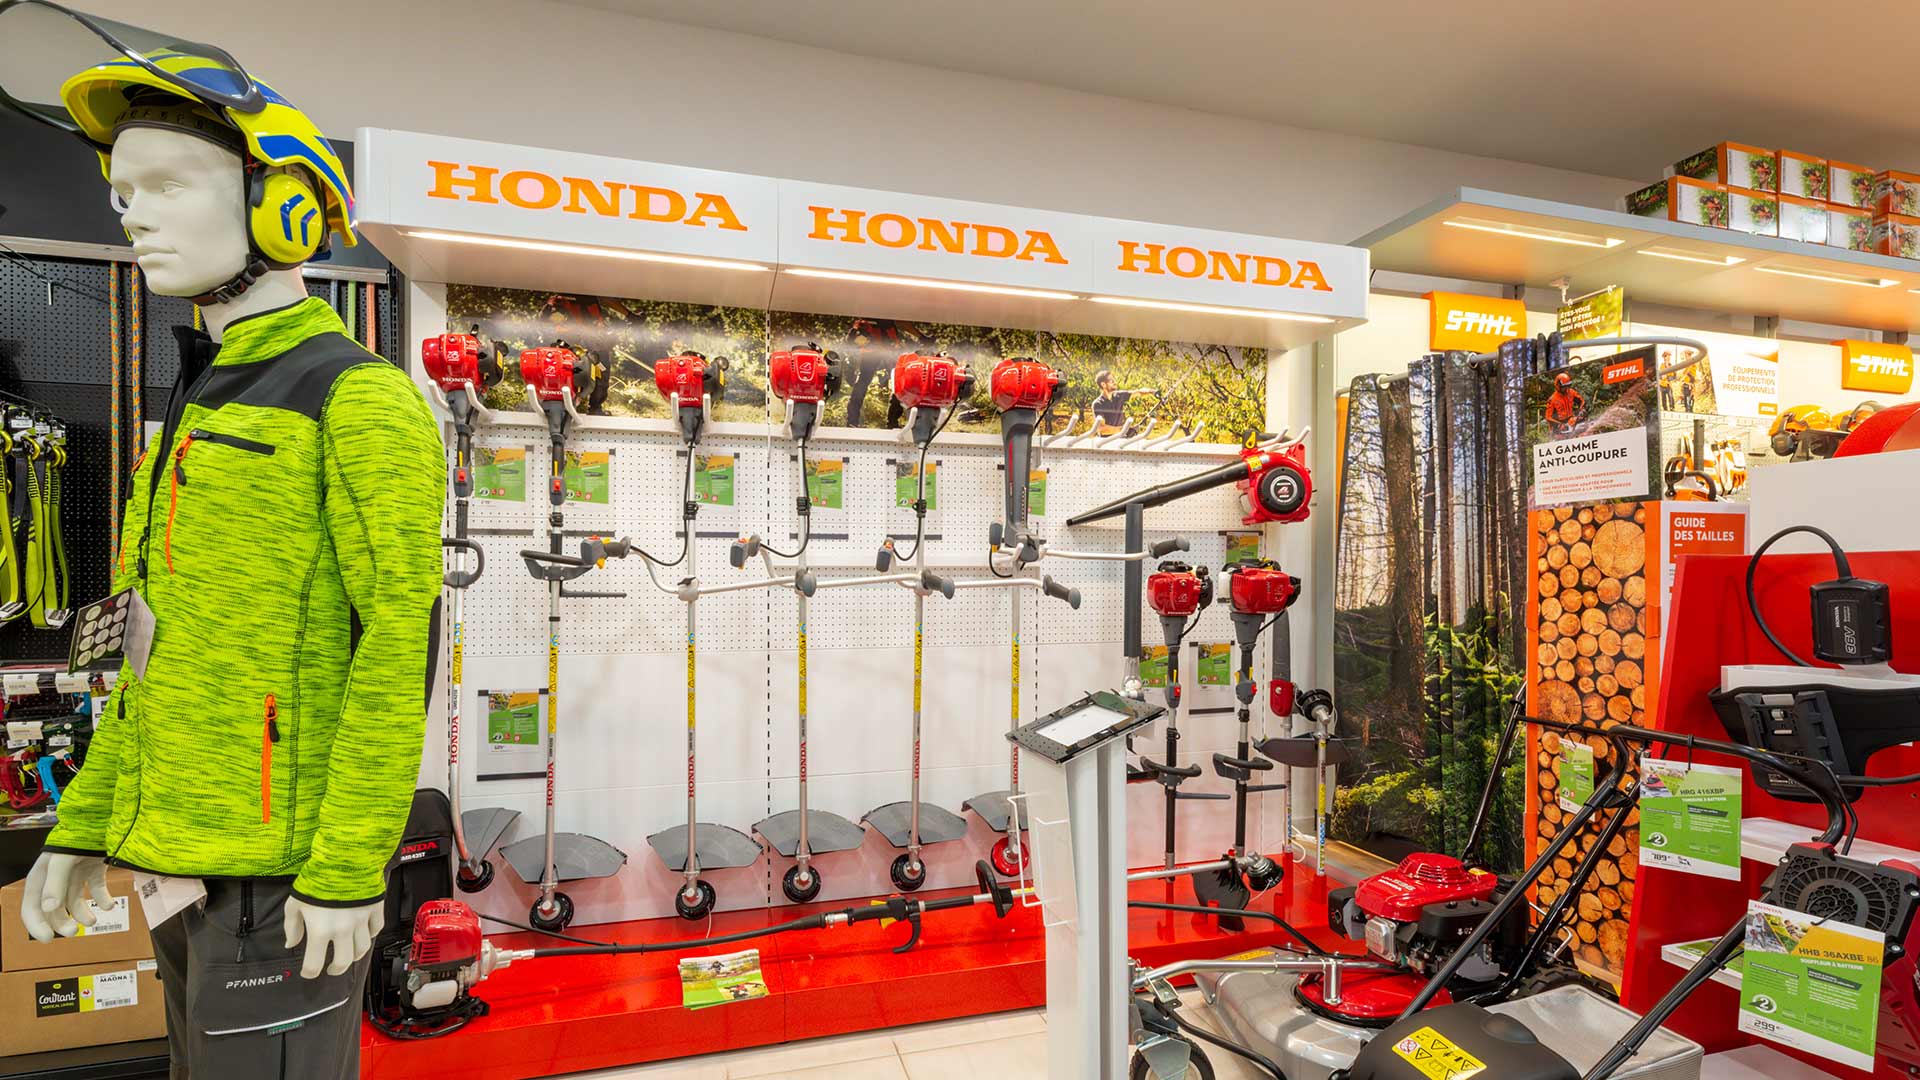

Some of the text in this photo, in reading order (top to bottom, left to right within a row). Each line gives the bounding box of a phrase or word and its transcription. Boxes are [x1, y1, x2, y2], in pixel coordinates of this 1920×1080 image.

[426, 159, 748, 232] HONDA
[807, 205, 1069, 265] HONDA
[1117, 239, 1334, 292] HONDA
[1444, 309, 1519, 337] STIHL
[1606, 364, 1640, 380] STIHL
[1849, 354, 1909, 377] STIHL
[1722, 383, 1776, 395] PROFESSIONNELS
[1727, 374, 1776, 386] DE PROTECTION
[1539, 439, 1599, 458] LA GAMME
[1539, 447, 1628, 470] ANTI-COUPURE
[1674, 517, 1706, 528] GUIDE
[1674, 530, 1735, 542] DES TAILLES
[1843, 626, 1857, 654] 36V
[450, 714, 459, 764] HONDA
[546, 761, 554, 807] HONDA
[687, 754, 695, 798] HONDA
[1798, 947, 1821, 957] HHB
[225, 974, 284, 989] PFANNER
